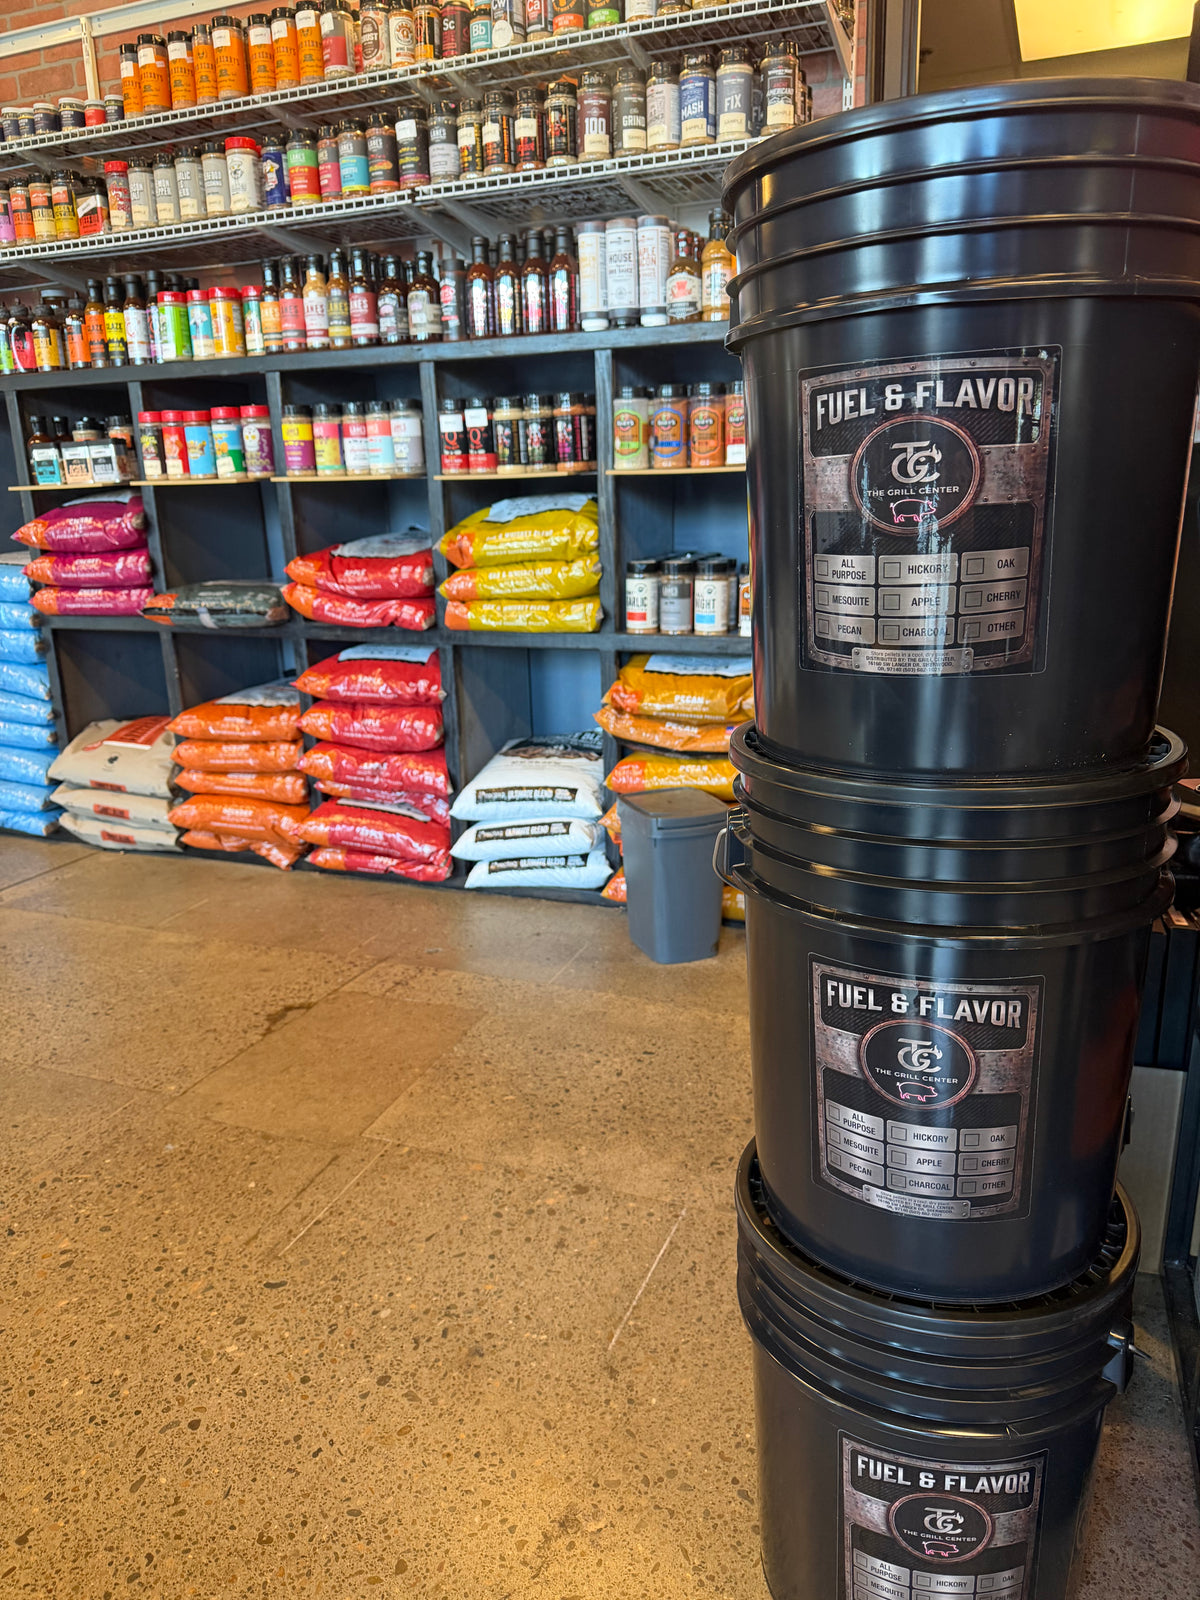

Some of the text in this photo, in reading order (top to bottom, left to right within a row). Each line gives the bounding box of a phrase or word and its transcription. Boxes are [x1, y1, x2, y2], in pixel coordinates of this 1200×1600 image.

[442, 18, 455, 31] Sc
[472, 23, 486, 37] Bb
[724, 94, 742, 113] FIX
[609, 252, 633, 264] HOUSE
[816, 377, 1034, 431] FUEL & FLAVOR
[867, 486, 960, 497] THE GRILL CENTER
[841, 559, 855, 568] ALL
[997, 558, 1015, 569] OAK
[831, 570, 867, 580] PURPOSE
[907, 564, 948, 575] HICKORY
[832, 594, 870, 606] MESQUITE
[911, 597, 941, 607] APPLE
[986, 590, 1021, 603] CHERRY
[837, 624, 862, 635] PECAN
[902, 627, 950, 637] CHARCOAL
[987, 621, 1016, 633] OTHER
[674, 694, 704, 705] PECAN
[826, 979, 1022, 1029] FUEL & FLAVOR
[875, 1067, 959, 1084] THE GRILL CENTER
[852, 1113, 865, 1123] ALL
[843, 1118, 876, 1135] PURPOSE
[913, 1132, 949, 1143] HICKORY
[990, 1134, 1006, 1143] OAK
[843, 1137, 879, 1156] MESQUITE
[916, 1158, 942, 1167] APPLE
[981, 1157, 1010, 1168] CHERRY
[849, 1162, 872, 1177] PECAN
[908, 1179, 951, 1191] CHARCOAL
[982, 1181, 1006, 1190] OTHER
[857, 1454, 1031, 1494] FUEL & FLAVOR
[902, 1528, 918, 1537] THE
[920, 1532, 944, 1541] GRILL
[879, 1562, 893, 1572] ALL
[870, 1566, 903, 1582] PURPOSE
[1002, 1575, 1015, 1583] OAK
[870, 1580, 905, 1599] MESQUITE
[936, 1580, 968, 1588] HICKORY
